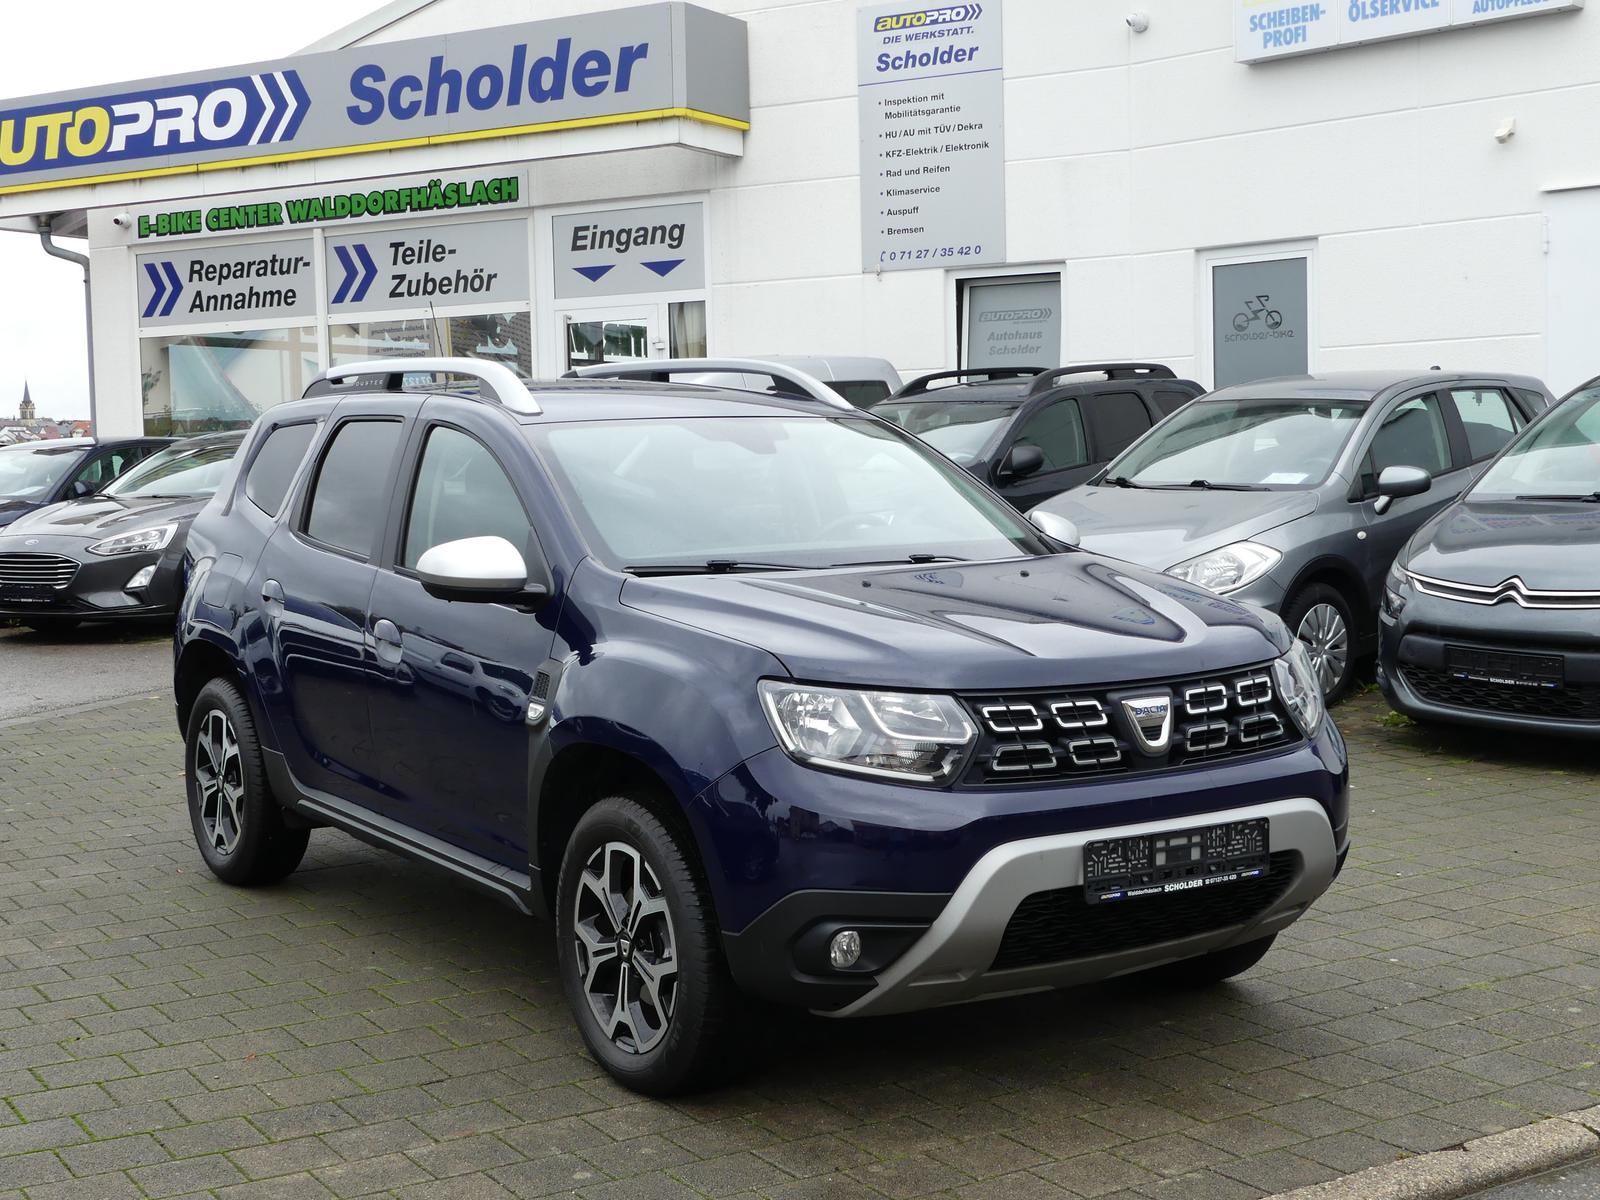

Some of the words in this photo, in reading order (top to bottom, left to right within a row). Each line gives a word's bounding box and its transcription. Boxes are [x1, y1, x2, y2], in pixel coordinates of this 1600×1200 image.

[1249, 3, 1326, 32] SCHEIBEN-
[883, 35, 902, 44] DIE
[905, 26, 974, 42] WERKSTATT.
[1263, 25, 1307, 49] PROFI
[876, 44, 979, 72] Scholder
[0, 87, 247, 166] UTOPRO
[346, 37, 649, 126] Scholder
[884, 95, 928, 107] Inspektion
[930, 92, 945, 101] mit
[884, 104, 961, 120] Mobilitätsgarantie
[917, 127, 931, 136] mit
[885, 145, 938, 159] KFZ-Elektrik
[945, 140, 989, 153] Elektronik
[886, 169, 902, 178] Rad
[904, 167, 920, 176] und
[923, 165, 950, 174] Reifen
[886, 185, 940, 197] Klimaservice
[138, 208, 202, 239] E-BIKE
[205, 201, 284, 232] CENTER
[286, 176, 519, 225] WALDDORFHÄSLACH
[886, 206, 919, 216] Auspuff
[571, 221, 686, 252] Eingang
[887, 226, 924, 236] Bremsen
[389, 238, 457, 266] Teile-
[188, 254, 311, 285] Reparatur-
[388, 268, 498, 299] Zubehör
[188, 286, 297, 313] Annahme
[986, 330, 1043, 342] Autohaus
[988, 344, 1042, 356] Scholder
[1135, 705, 1166, 715] DACIA
[1164, 879, 1203, 893] SCHOLDER
